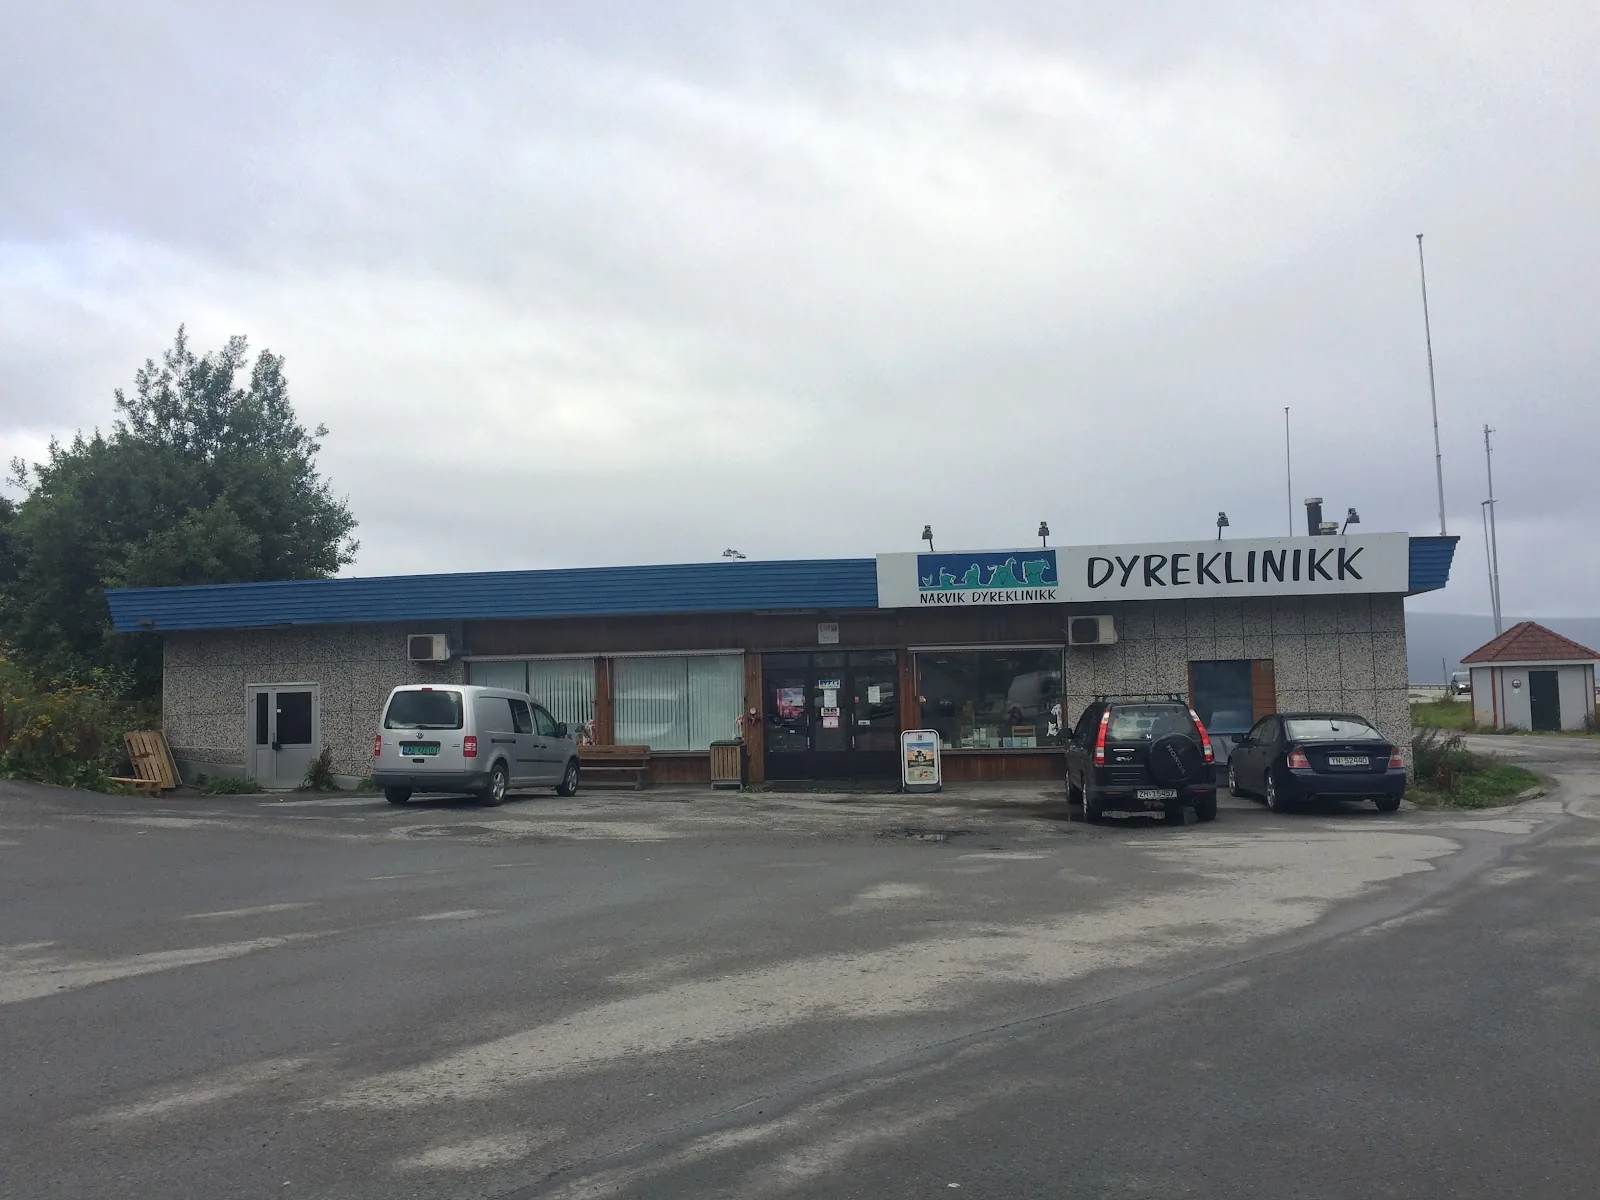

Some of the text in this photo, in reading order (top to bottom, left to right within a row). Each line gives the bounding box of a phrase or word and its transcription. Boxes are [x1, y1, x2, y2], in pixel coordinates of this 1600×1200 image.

[1087, 547, 1364, 588] DYREKLINIKK
[920, 589, 1057, 604] NARVIK DYREKLINIKK
[1165, 744, 1186, 775] HONDA
